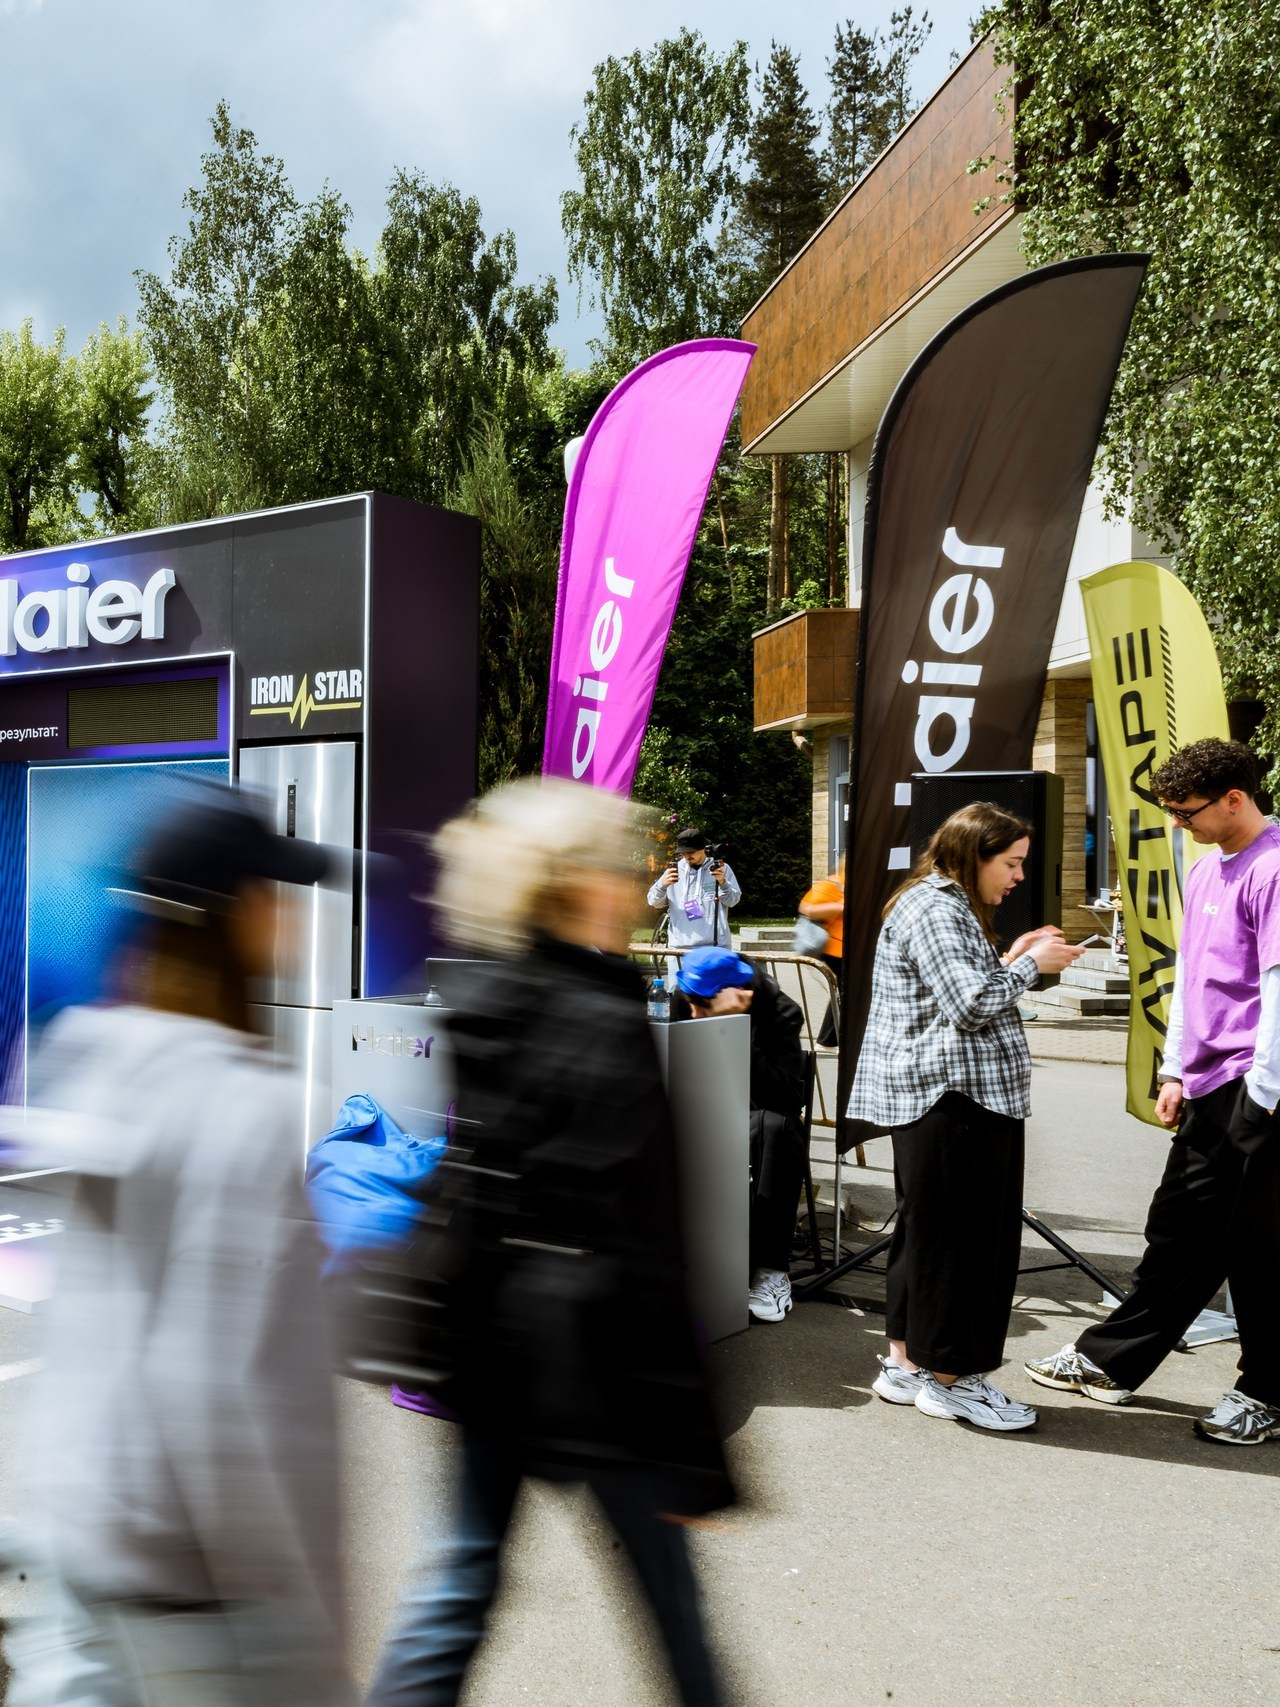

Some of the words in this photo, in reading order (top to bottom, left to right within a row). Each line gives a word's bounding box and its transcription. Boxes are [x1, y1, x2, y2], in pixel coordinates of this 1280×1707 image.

[251, 674, 294, 705] IRON
[314, 669, 363, 701] STAR
[888, 526, 1005, 870] aier
[351, 1023, 435, 1059] Haier
